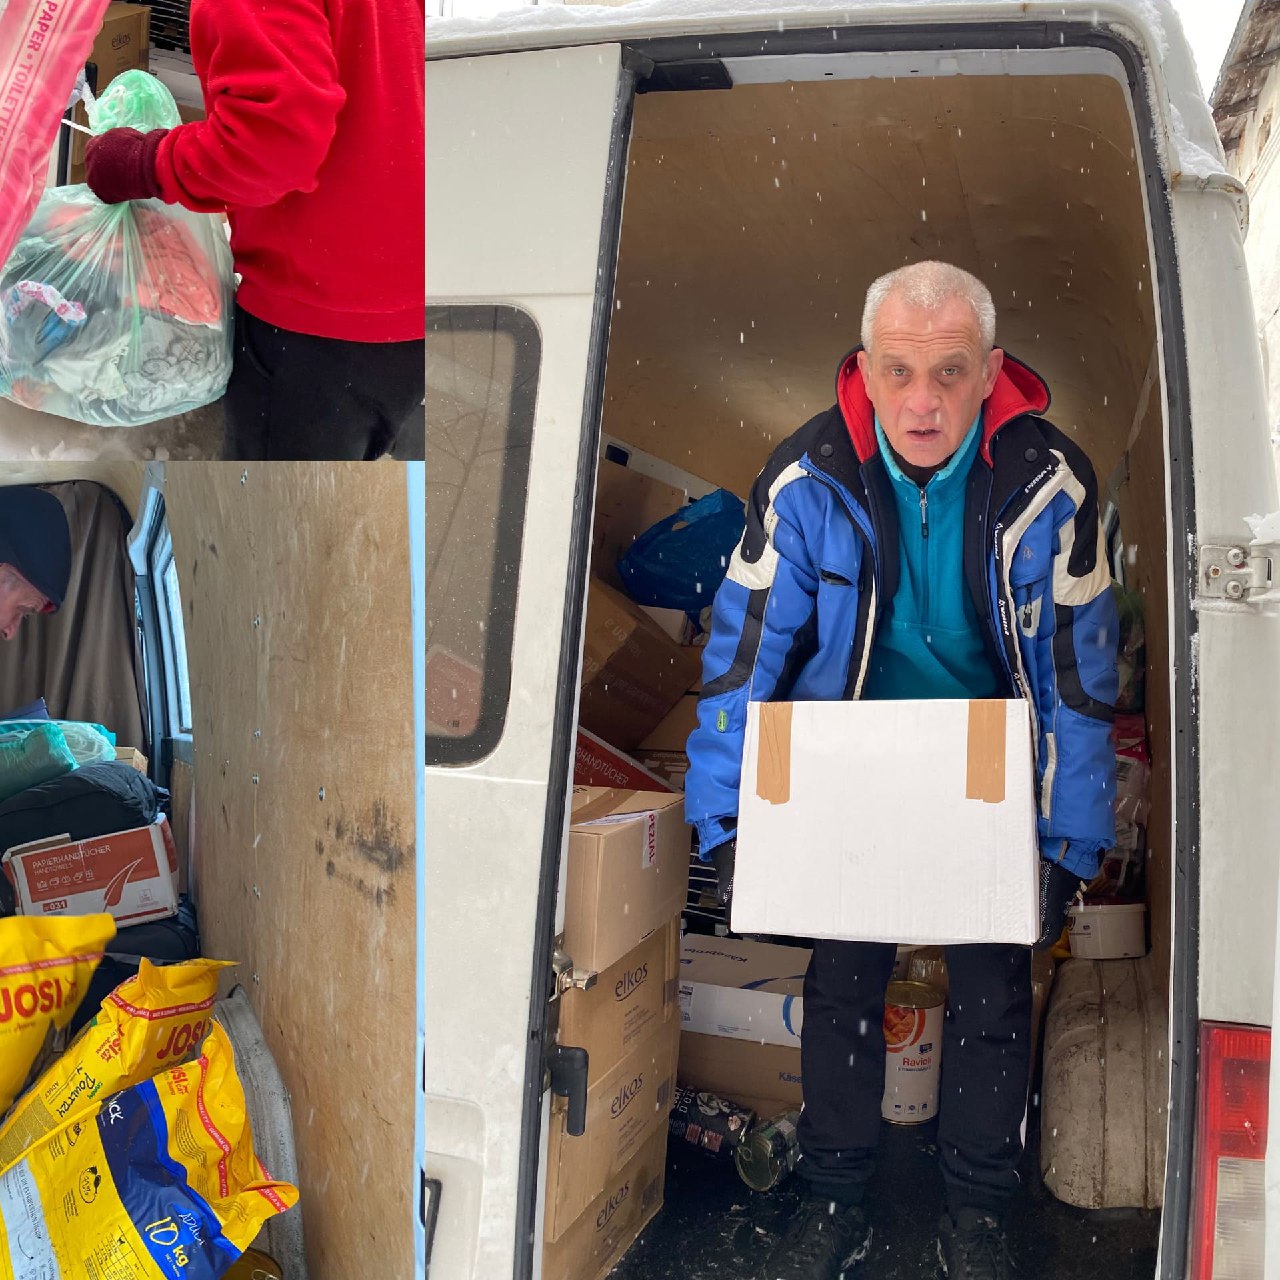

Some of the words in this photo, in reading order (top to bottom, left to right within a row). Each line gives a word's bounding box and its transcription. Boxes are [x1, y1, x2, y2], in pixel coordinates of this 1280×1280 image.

[27, 1, 58, 52] PAPER
[575, 746, 629, 787] RHANDTÜCHER
[614, 962, 649, 1001] elkos
[902, 1057, 932, 1067] Ravioli
[610, 1071, 644, 1118] elkos
[596, 1179, 630, 1231] elkos
[145, 1216, 179, 1245] 10
[172, 1245, 190, 1267] kg
